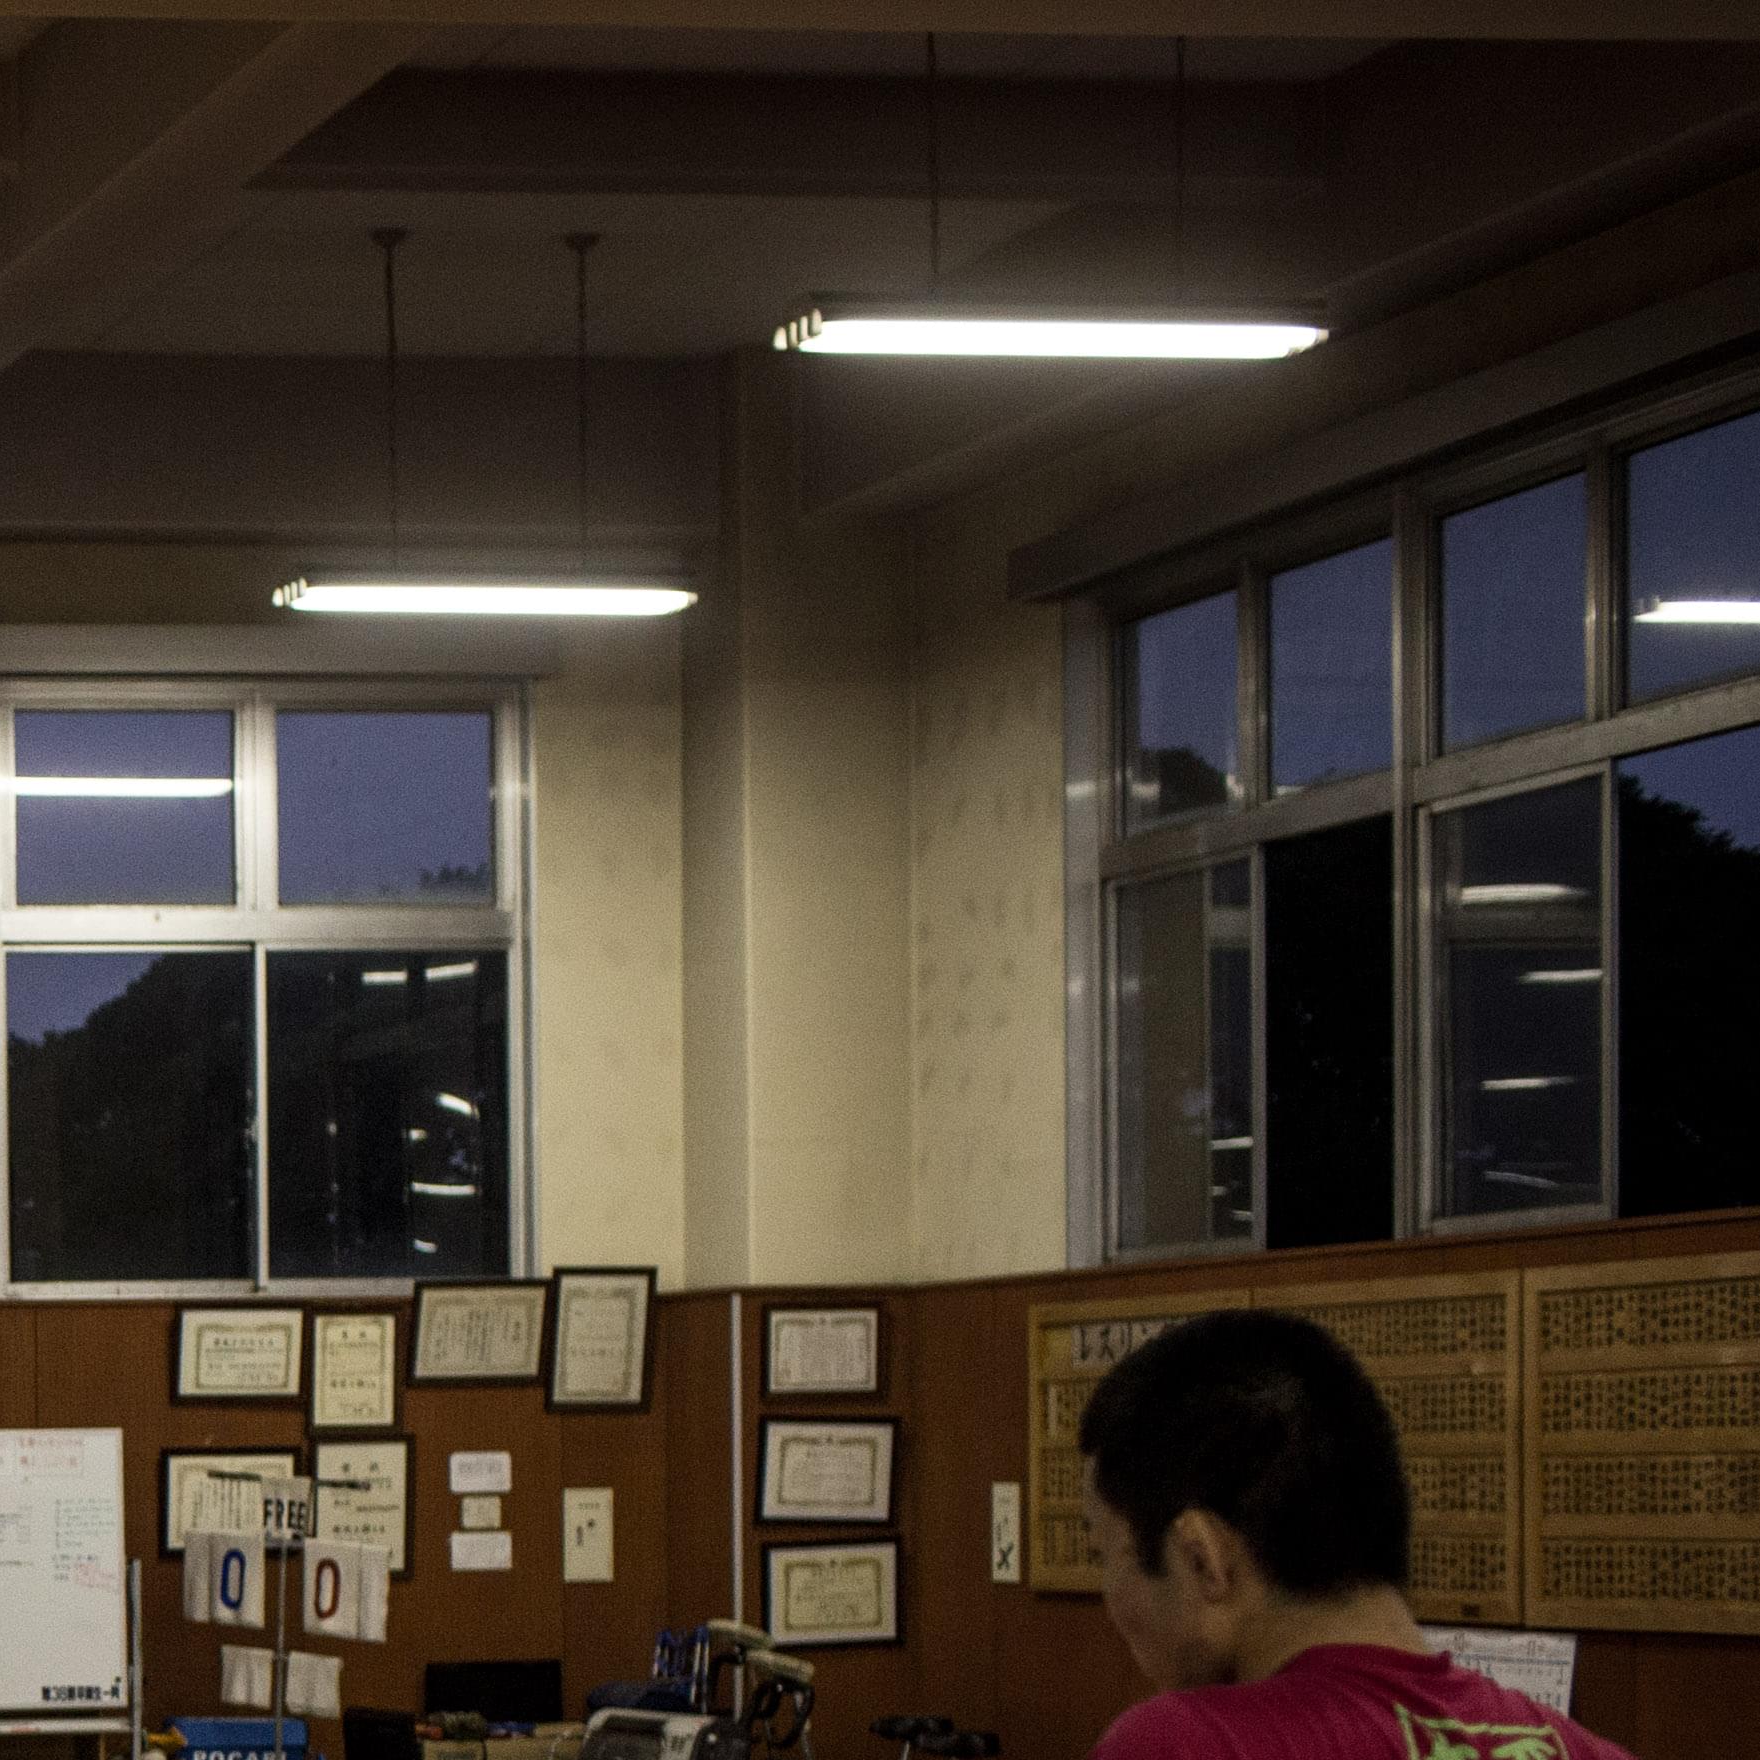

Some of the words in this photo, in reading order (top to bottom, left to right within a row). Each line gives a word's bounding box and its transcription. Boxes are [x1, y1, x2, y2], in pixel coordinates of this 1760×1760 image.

[264, 1499, 307, 1531] FREE
[221, 1548, 246, 1611] 0
[315, 1558, 340, 1619] 0
